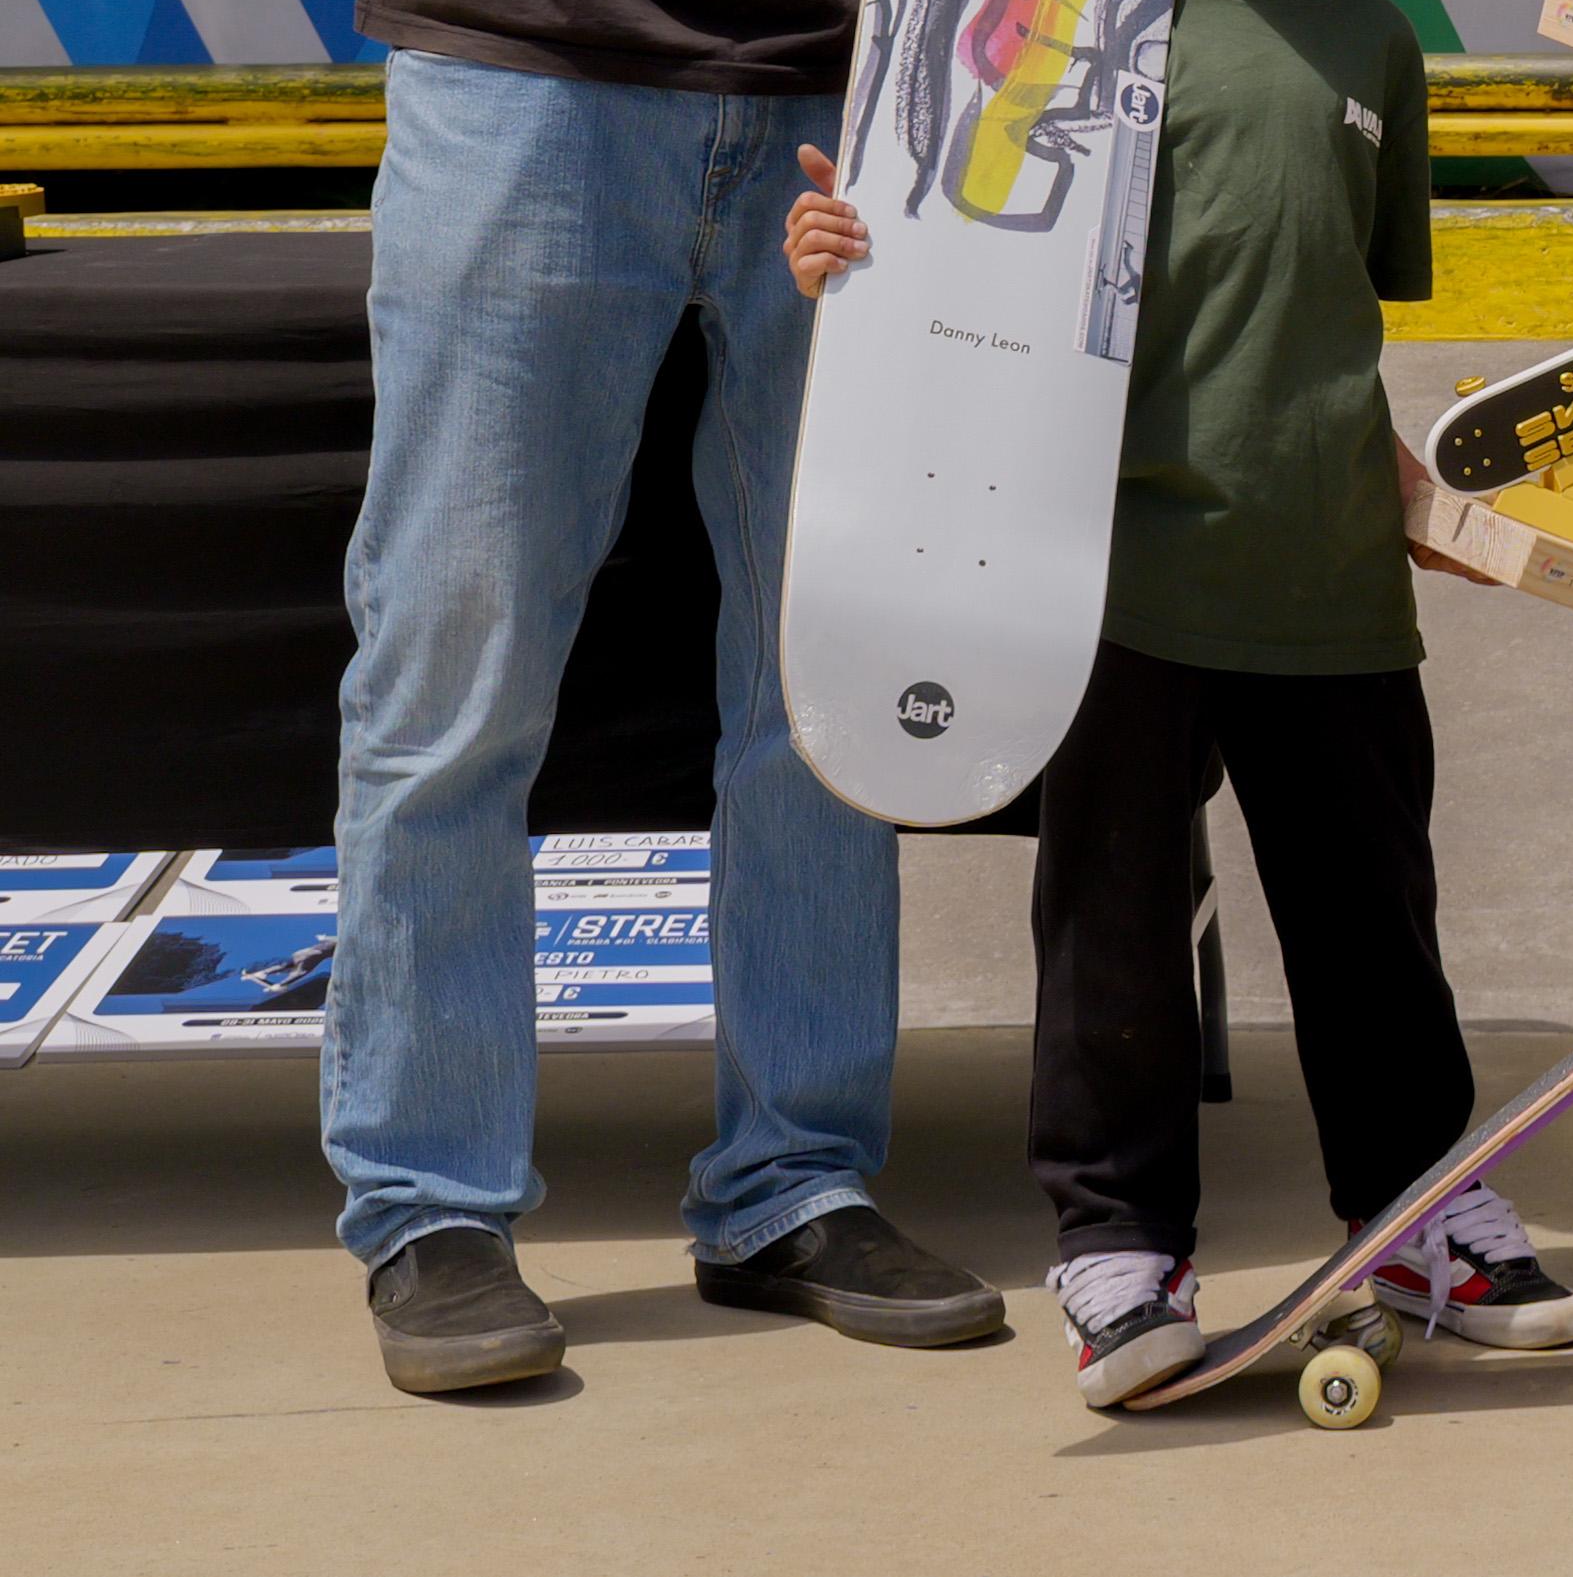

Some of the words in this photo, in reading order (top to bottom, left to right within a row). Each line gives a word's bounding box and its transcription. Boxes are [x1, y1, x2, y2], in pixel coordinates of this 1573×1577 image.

[1129, 82, 1150, 124] Jart
[929, 319, 985, 350] Danny
[991, 330, 1032, 354] Leon
[898, 693, 954, 729] Jart
[553, 836, 613, 850] LUIS
[624, 835, 711, 847] CABAR
[603, 878, 678, 887] PONTEVEDRA
[571, 914, 709, 939] STREE
[646, 937, 709, 945] CLASIFICAT
[535, 951, 595, 966] ESTO
[554, 969, 649, 981] PIETRO
[537, 1012, 590, 1020] TEVEDRA
